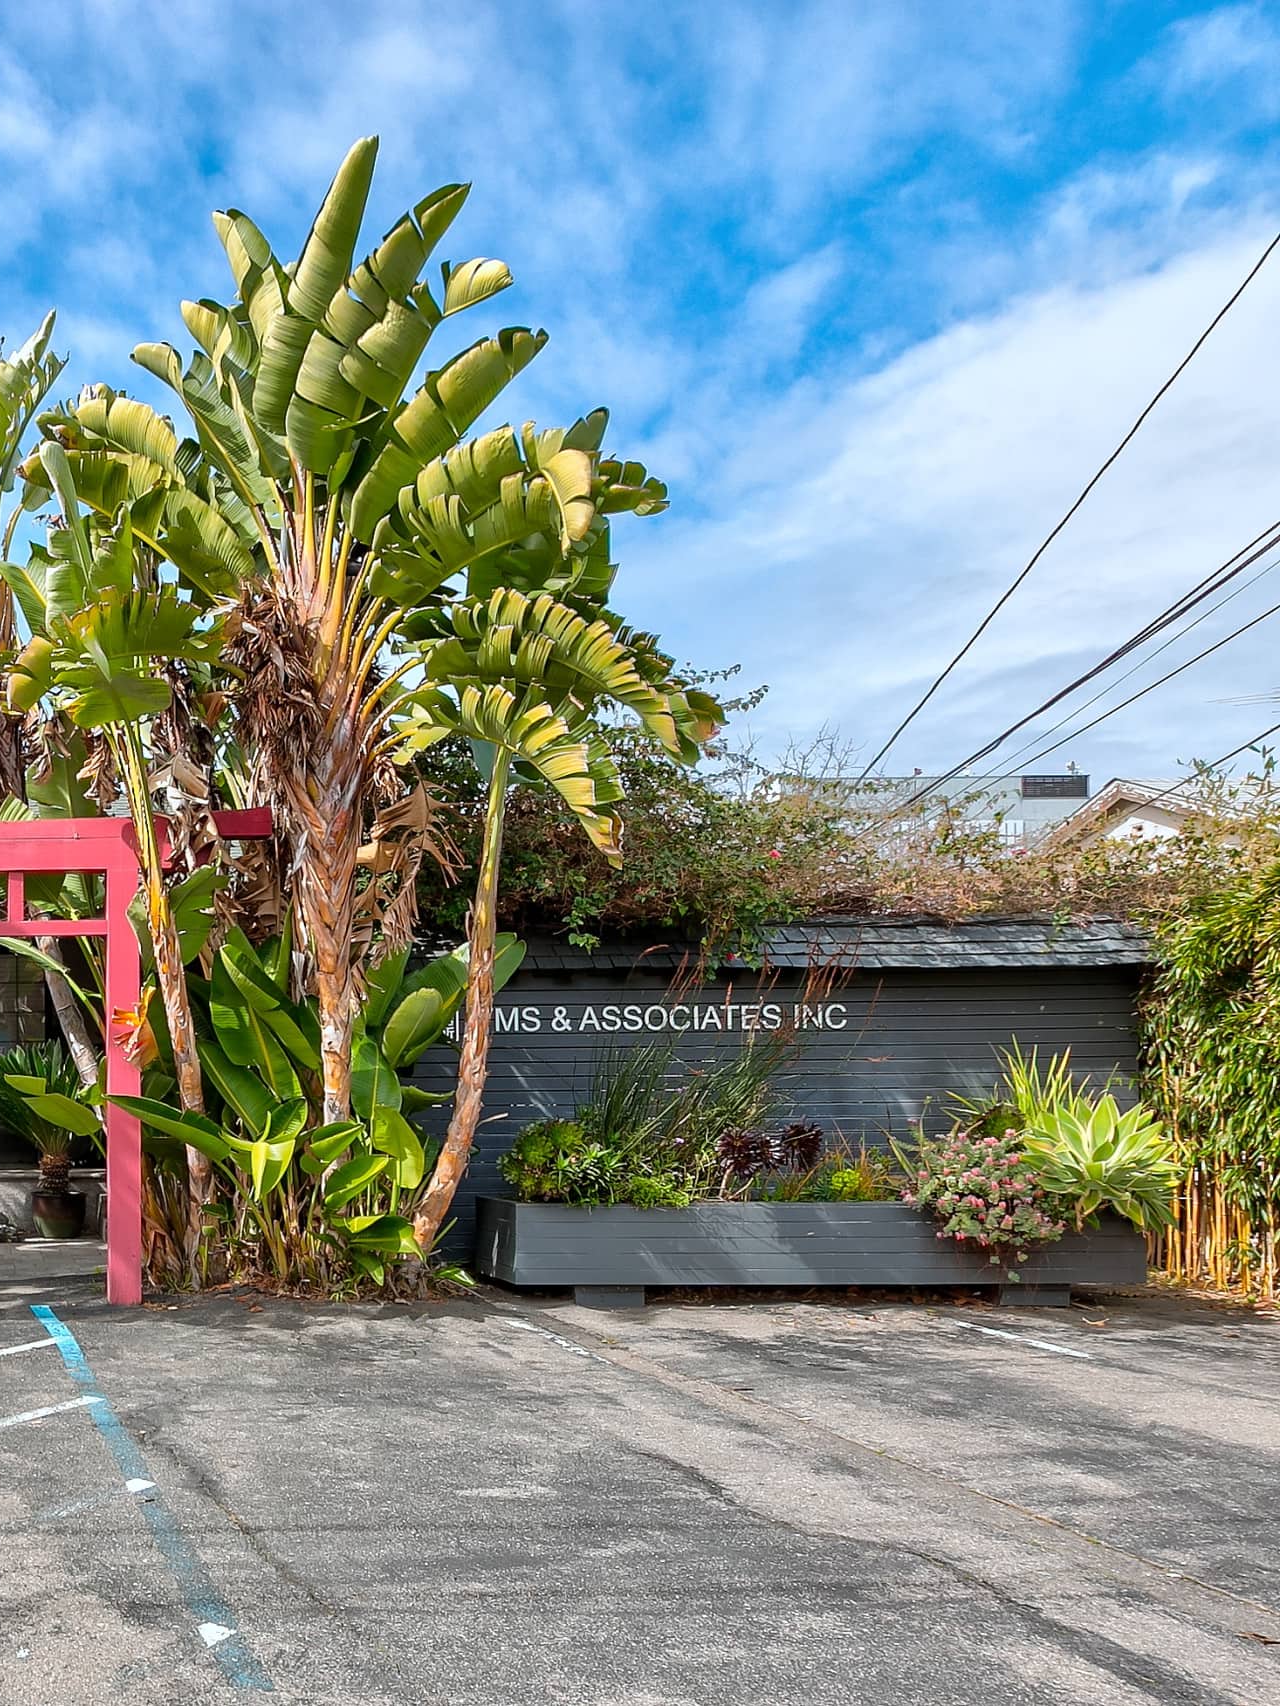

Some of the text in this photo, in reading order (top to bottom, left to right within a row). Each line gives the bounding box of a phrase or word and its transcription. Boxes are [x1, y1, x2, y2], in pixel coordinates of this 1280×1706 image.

[491, 1004, 848, 1032] MS & ASSOCIATES INC
